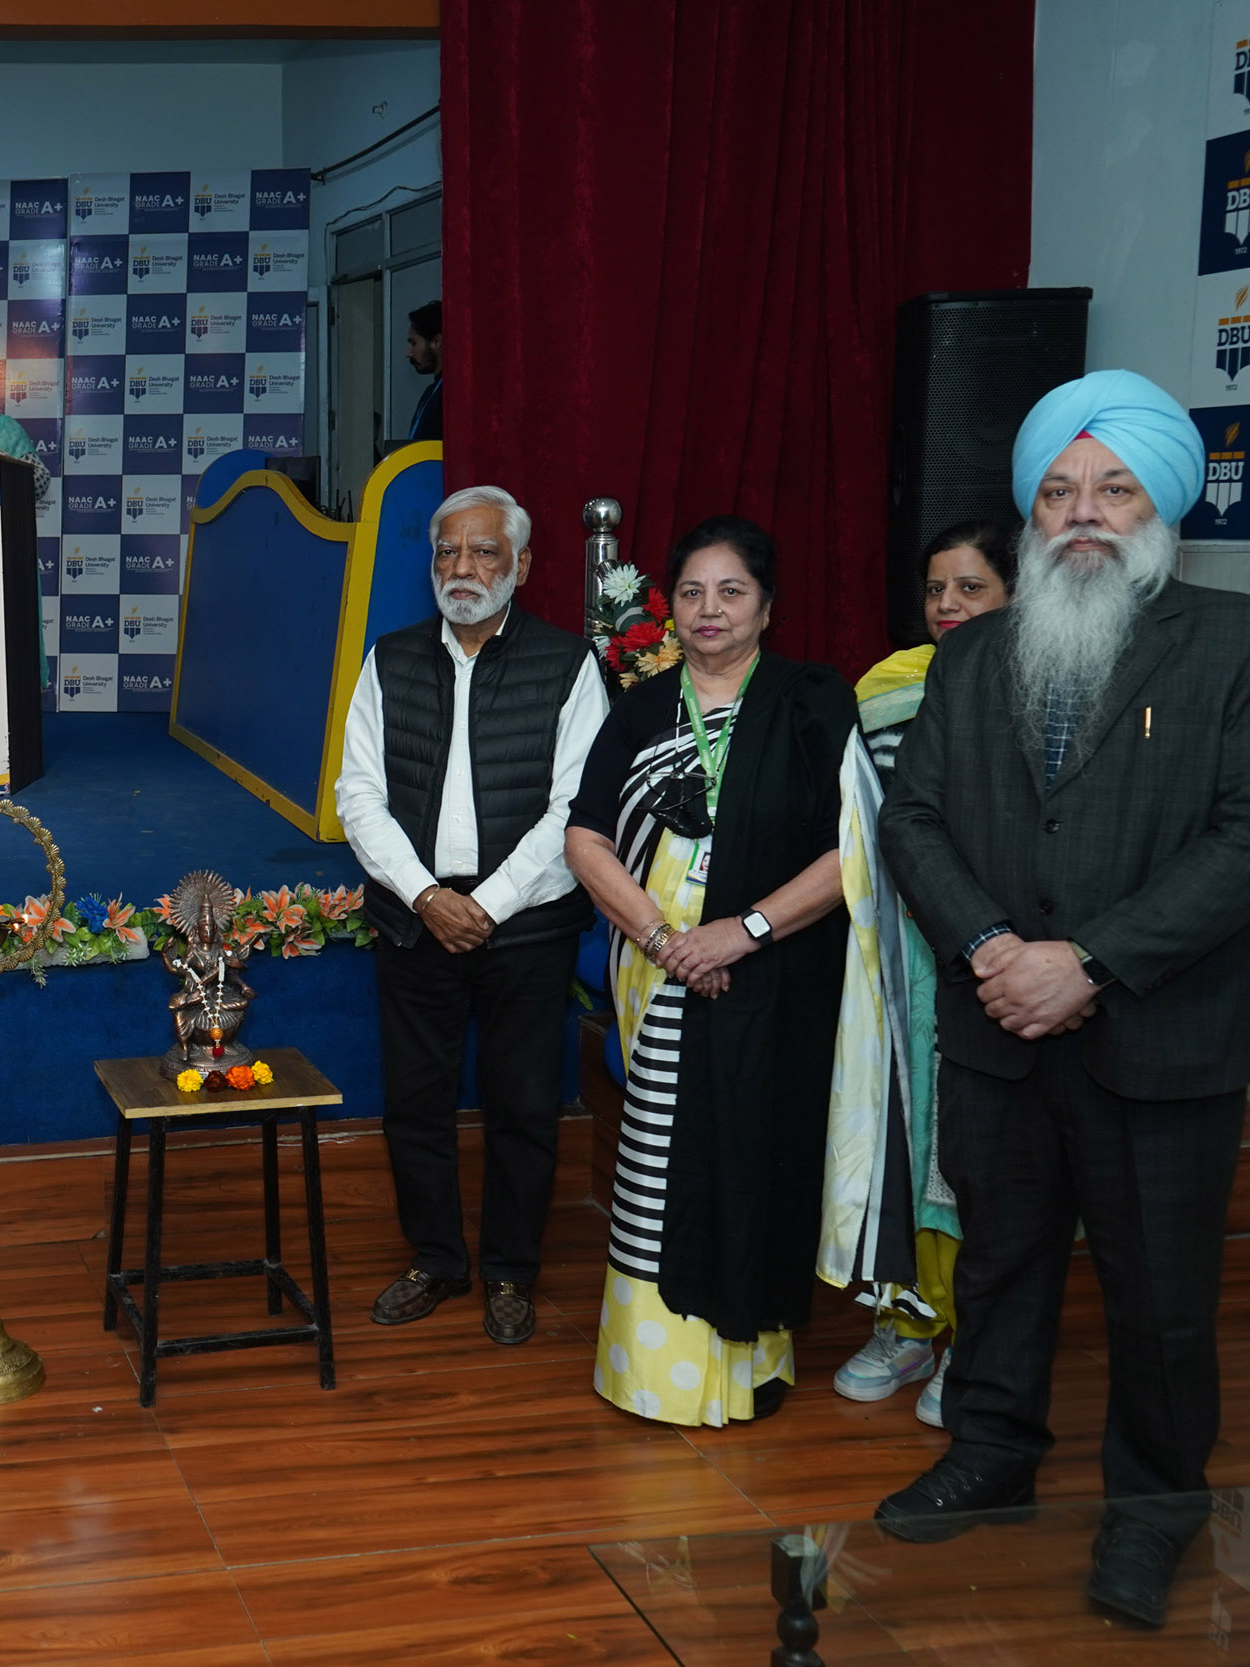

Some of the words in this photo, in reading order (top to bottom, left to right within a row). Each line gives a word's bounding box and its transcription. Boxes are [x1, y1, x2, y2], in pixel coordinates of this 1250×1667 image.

[135, 194, 160, 202] NAAC
[161, 194, 184, 207] A+
[195, 197, 212, 205] DBU
[256, 191, 282, 199] NAAC
[283, 190, 306, 204] A+
[1226, 188, 1250, 211] DB
[15, 201, 40, 209] NAAC
[41, 200, 63, 214] A+
[76, 201, 93, 209] DBU
[133, 259, 150, 267] DBU
[193, 253, 219, 261] NAAC
[220, 253, 243, 266] A+
[254, 257, 272, 265] DBU
[132, 315, 157, 323] NAAC
[158, 315, 181, 328] A+
[191, 319, 209, 327] DBU
[253, 313, 278, 321] NAAC
[279, 313, 303, 326] A+
[73, 321, 90, 329] DBU
[1216, 325, 1250, 347] DBU
[71, 376, 96, 384] NAAC
[97, 376, 120, 389] A+
[130, 380, 147, 388] DBU
[216, 375, 239, 388] A+
[35, 439, 57, 452] A+
[155, 436, 177, 449] A+
[276, 435, 299, 448] A+
[1207, 461, 1245, 481] DBU
[94, 496, 116, 509] A+
[127, 500, 144, 508] DBU
[152, 556, 174, 569] A+
[92, 615, 114, 628] A+
[64, 678, 81, 686] DBU
[149, 675, 172, 688] A+
